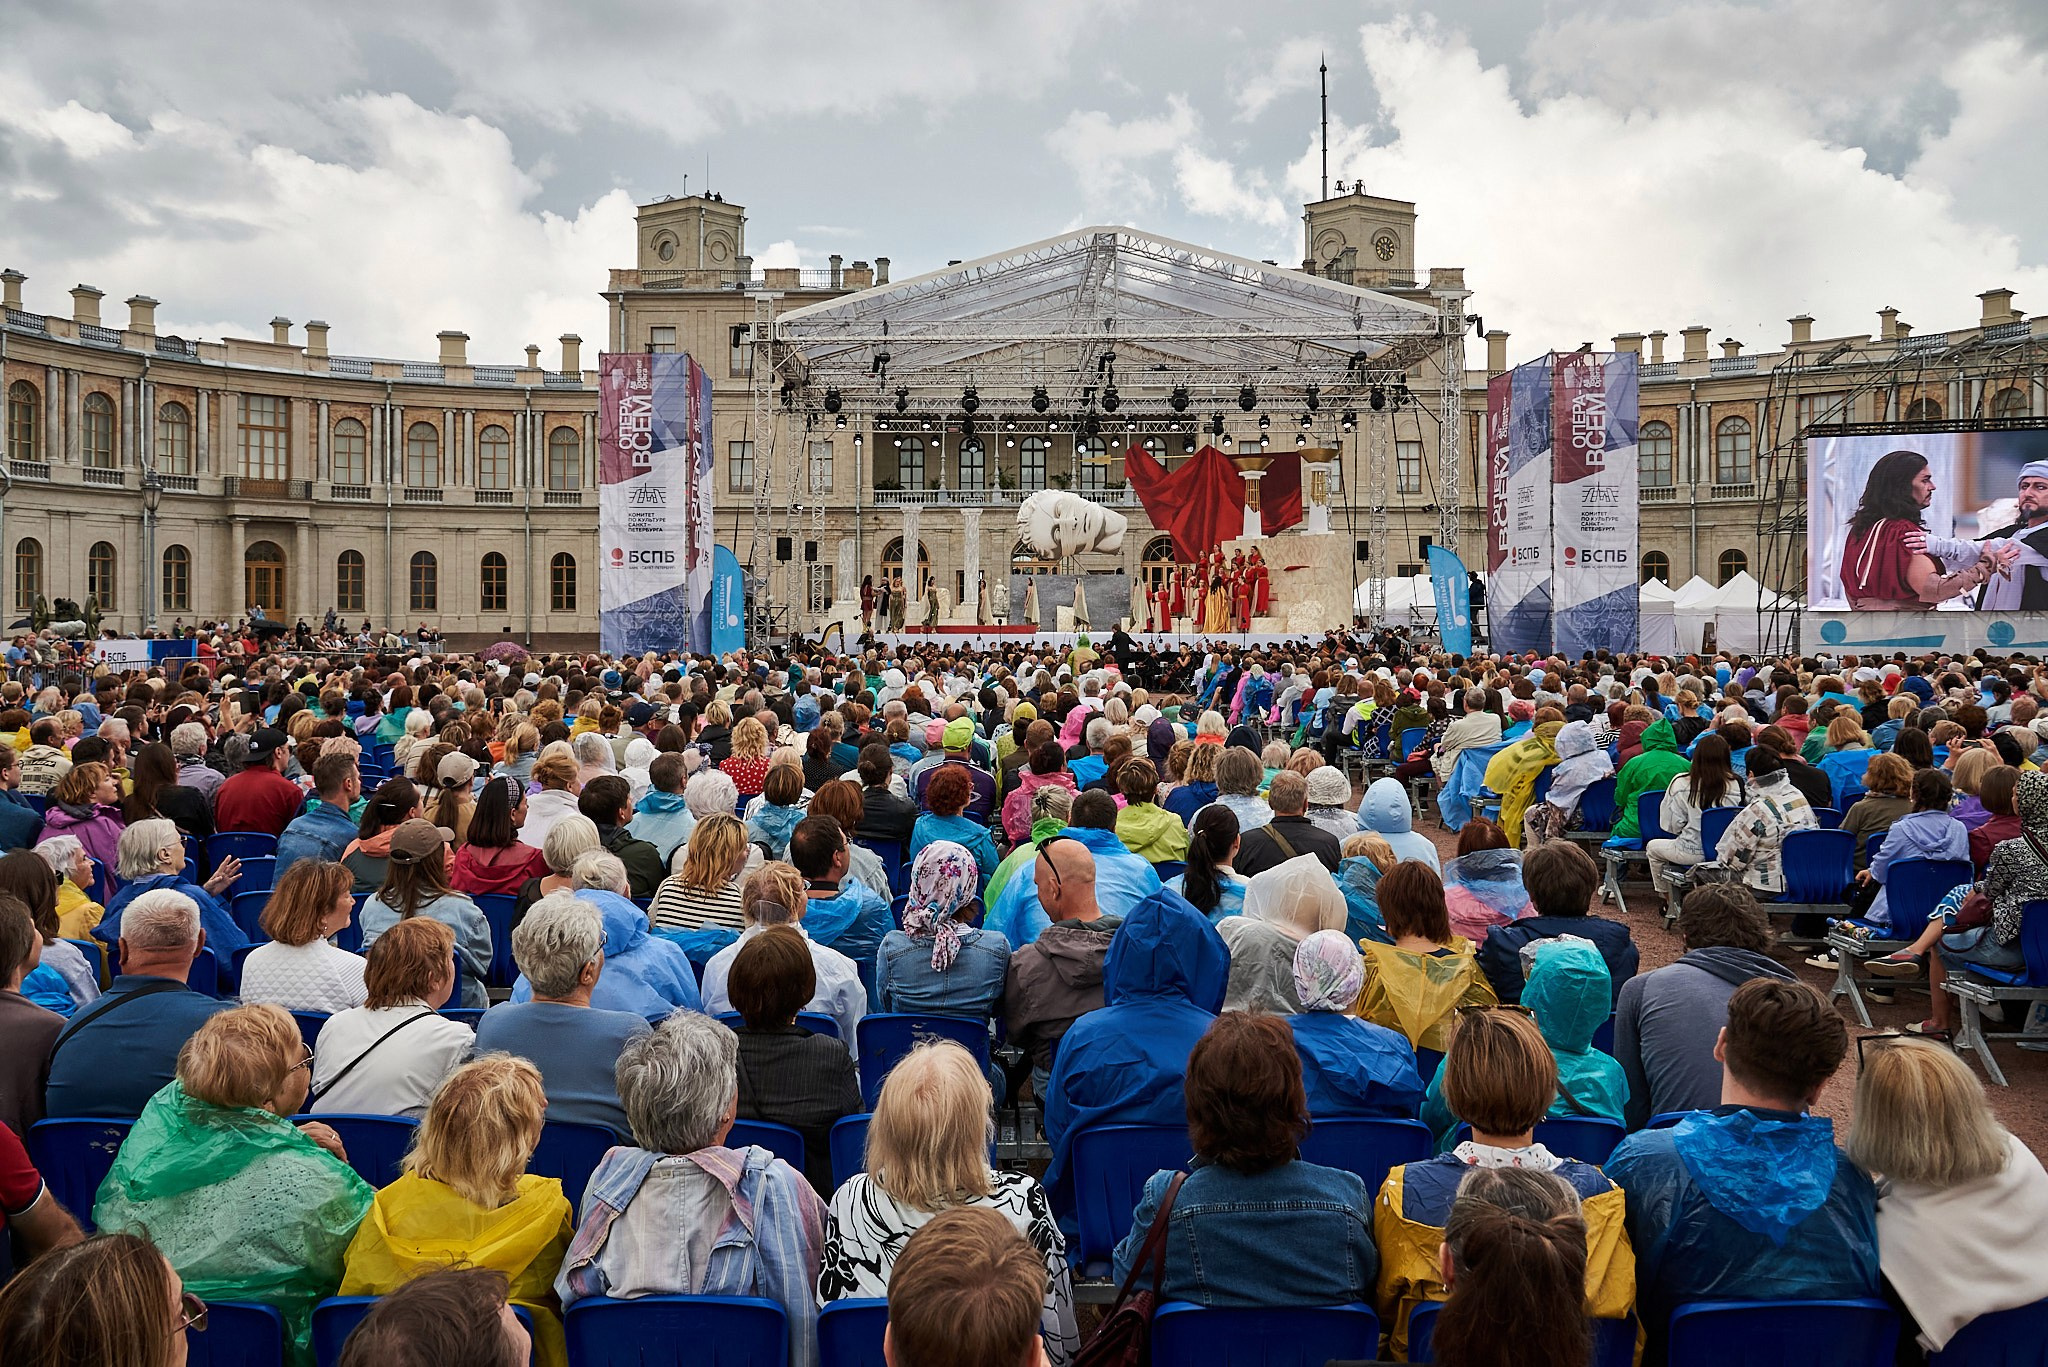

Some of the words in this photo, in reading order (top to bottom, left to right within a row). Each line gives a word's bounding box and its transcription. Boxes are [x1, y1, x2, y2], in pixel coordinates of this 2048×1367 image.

[619, 391, 632, 450] ОПЕРА-
[632, 395, 652, 467] ВСЕМ
[1572, 389, 1586, 449] ОПЕРА-
[1586, 394, 1606, 466] ВСЕМ
[1498, 446, 1509, 551] ВСЕМ
[629, 550, 675, 563] БСПБ
[1518, 547, 1539, 560] БСПБ
[1581, 550, 1627, 562] БСПБ
[108, 652, 126, 662] БСПБ
